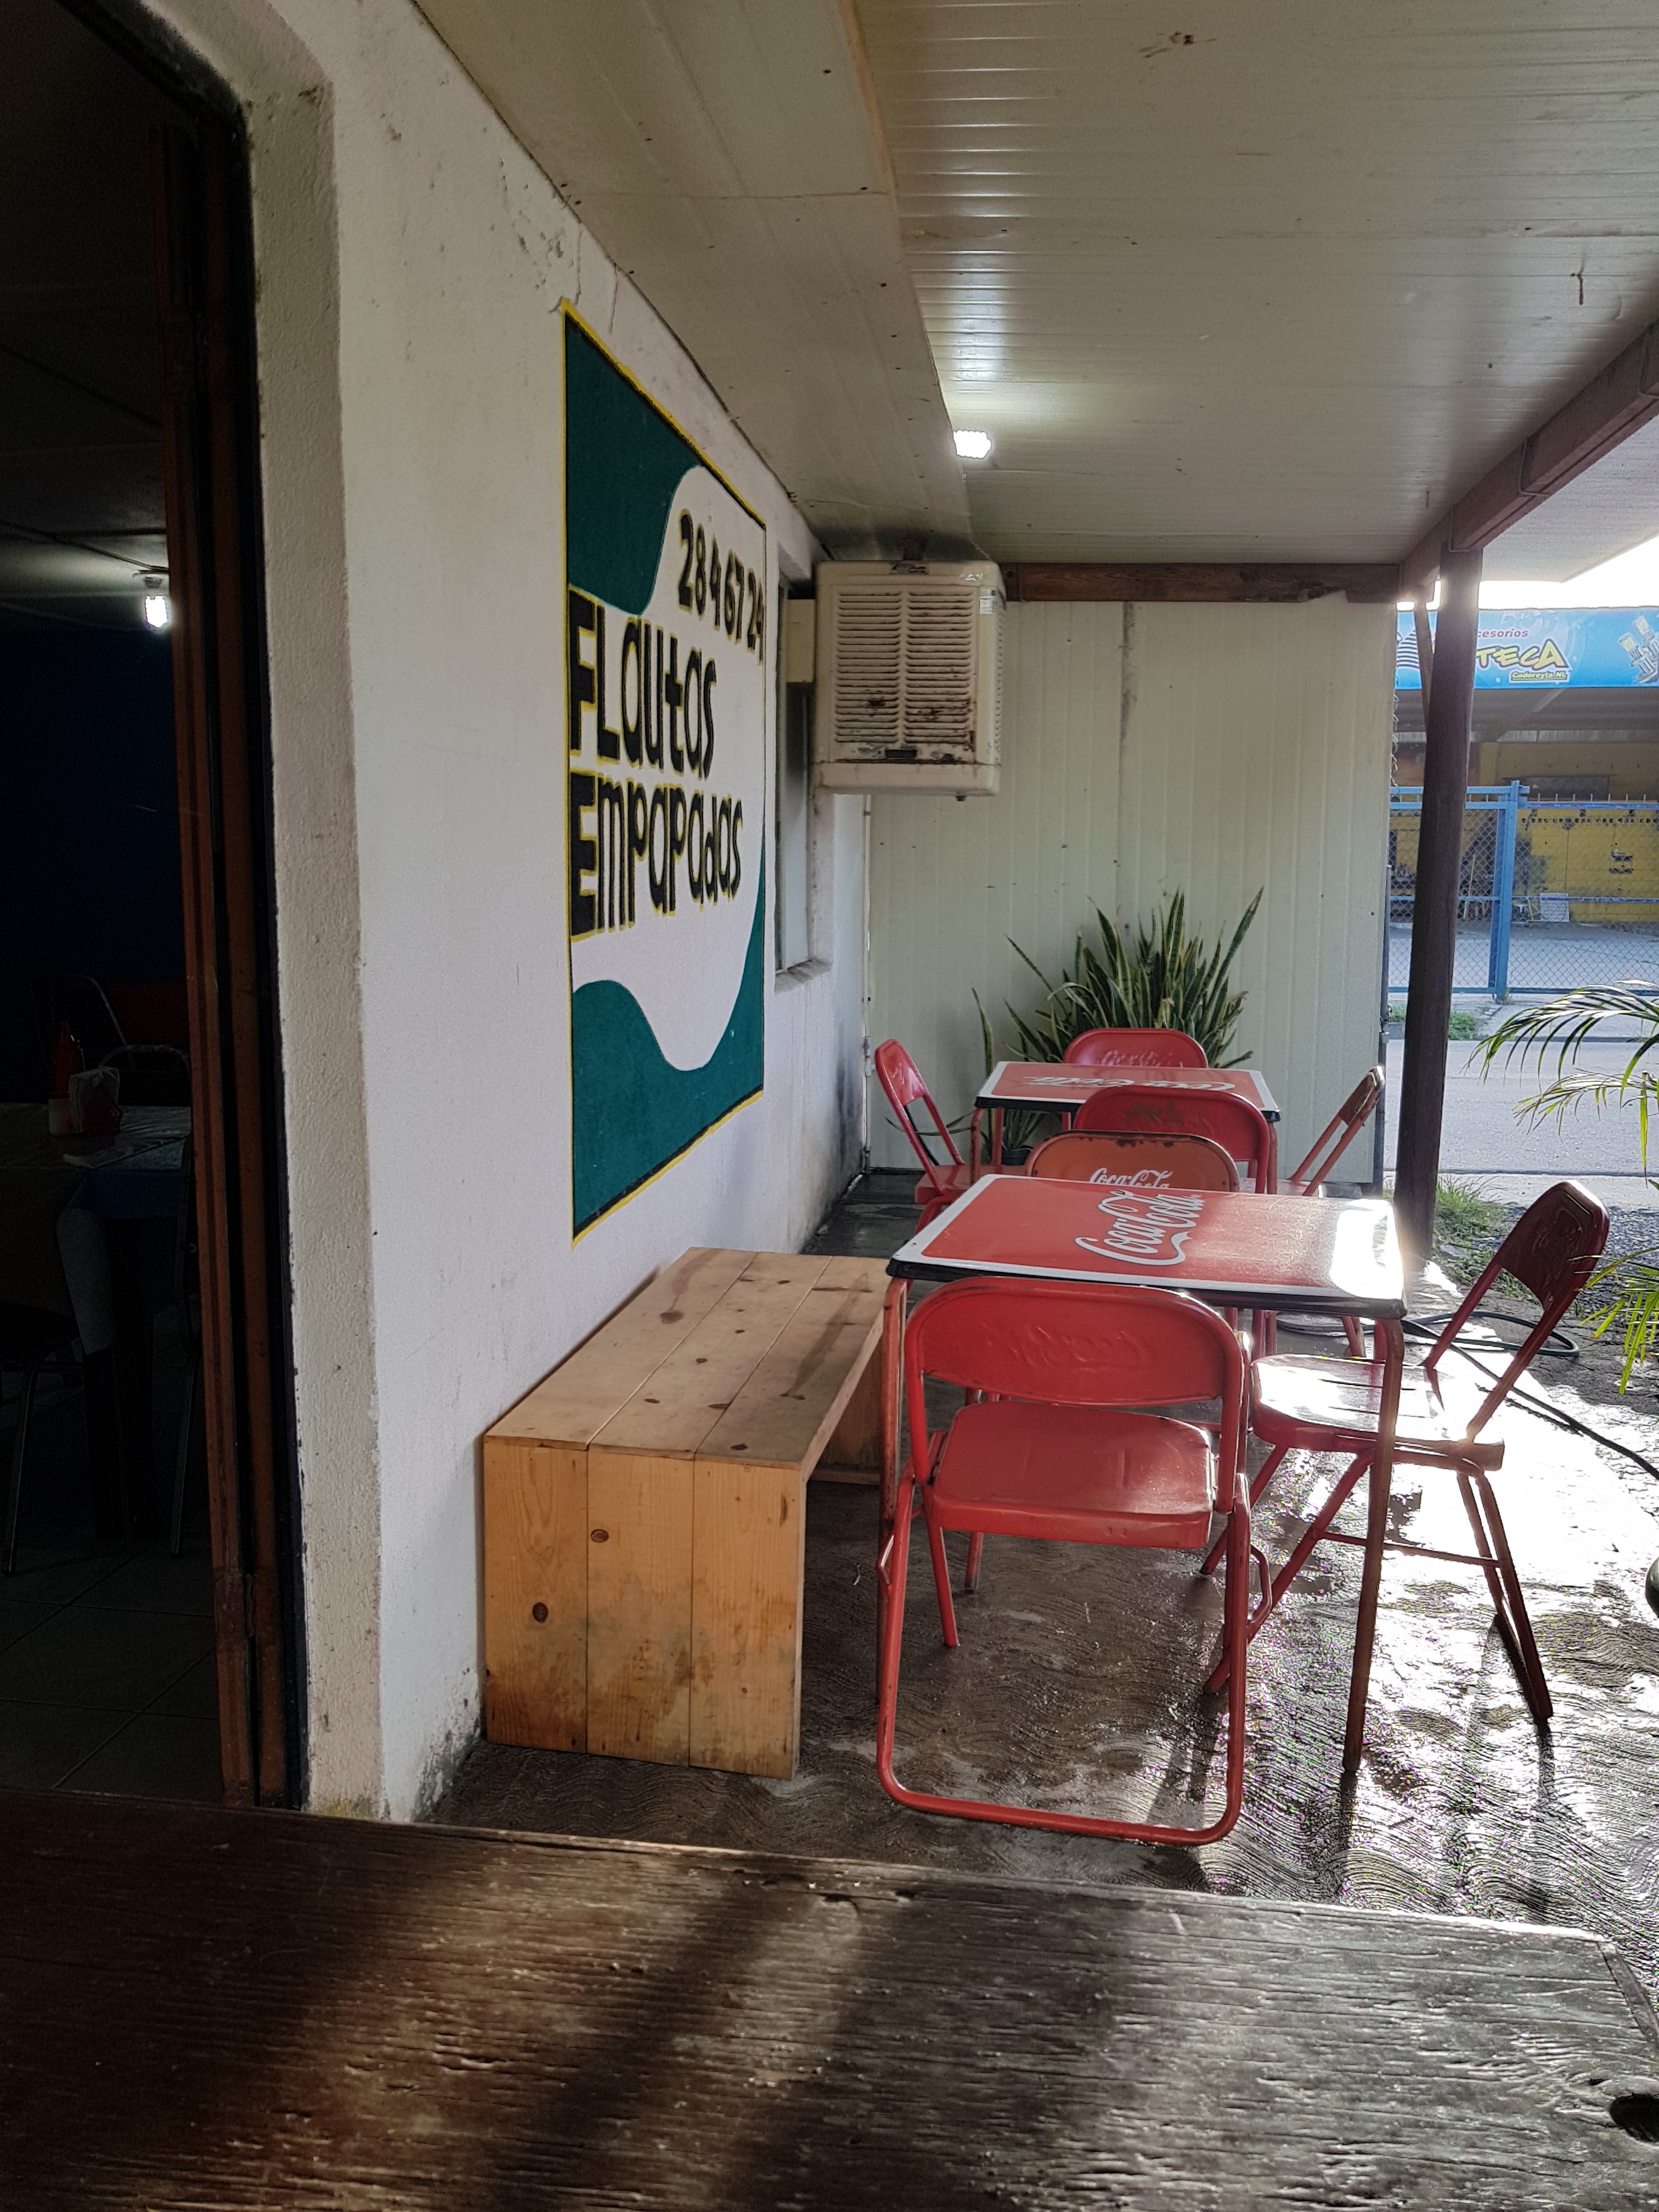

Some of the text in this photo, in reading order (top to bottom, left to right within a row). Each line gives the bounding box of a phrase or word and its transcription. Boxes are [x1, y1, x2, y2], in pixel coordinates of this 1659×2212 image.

[1476, 639, 1569, 670] TECA
[1511, 671, 1554, 680] Cadereyta
[1025, 1076, 1235, 1091] CocaCola
[1074, 1189, 1204, 1265] Coca-Cola
